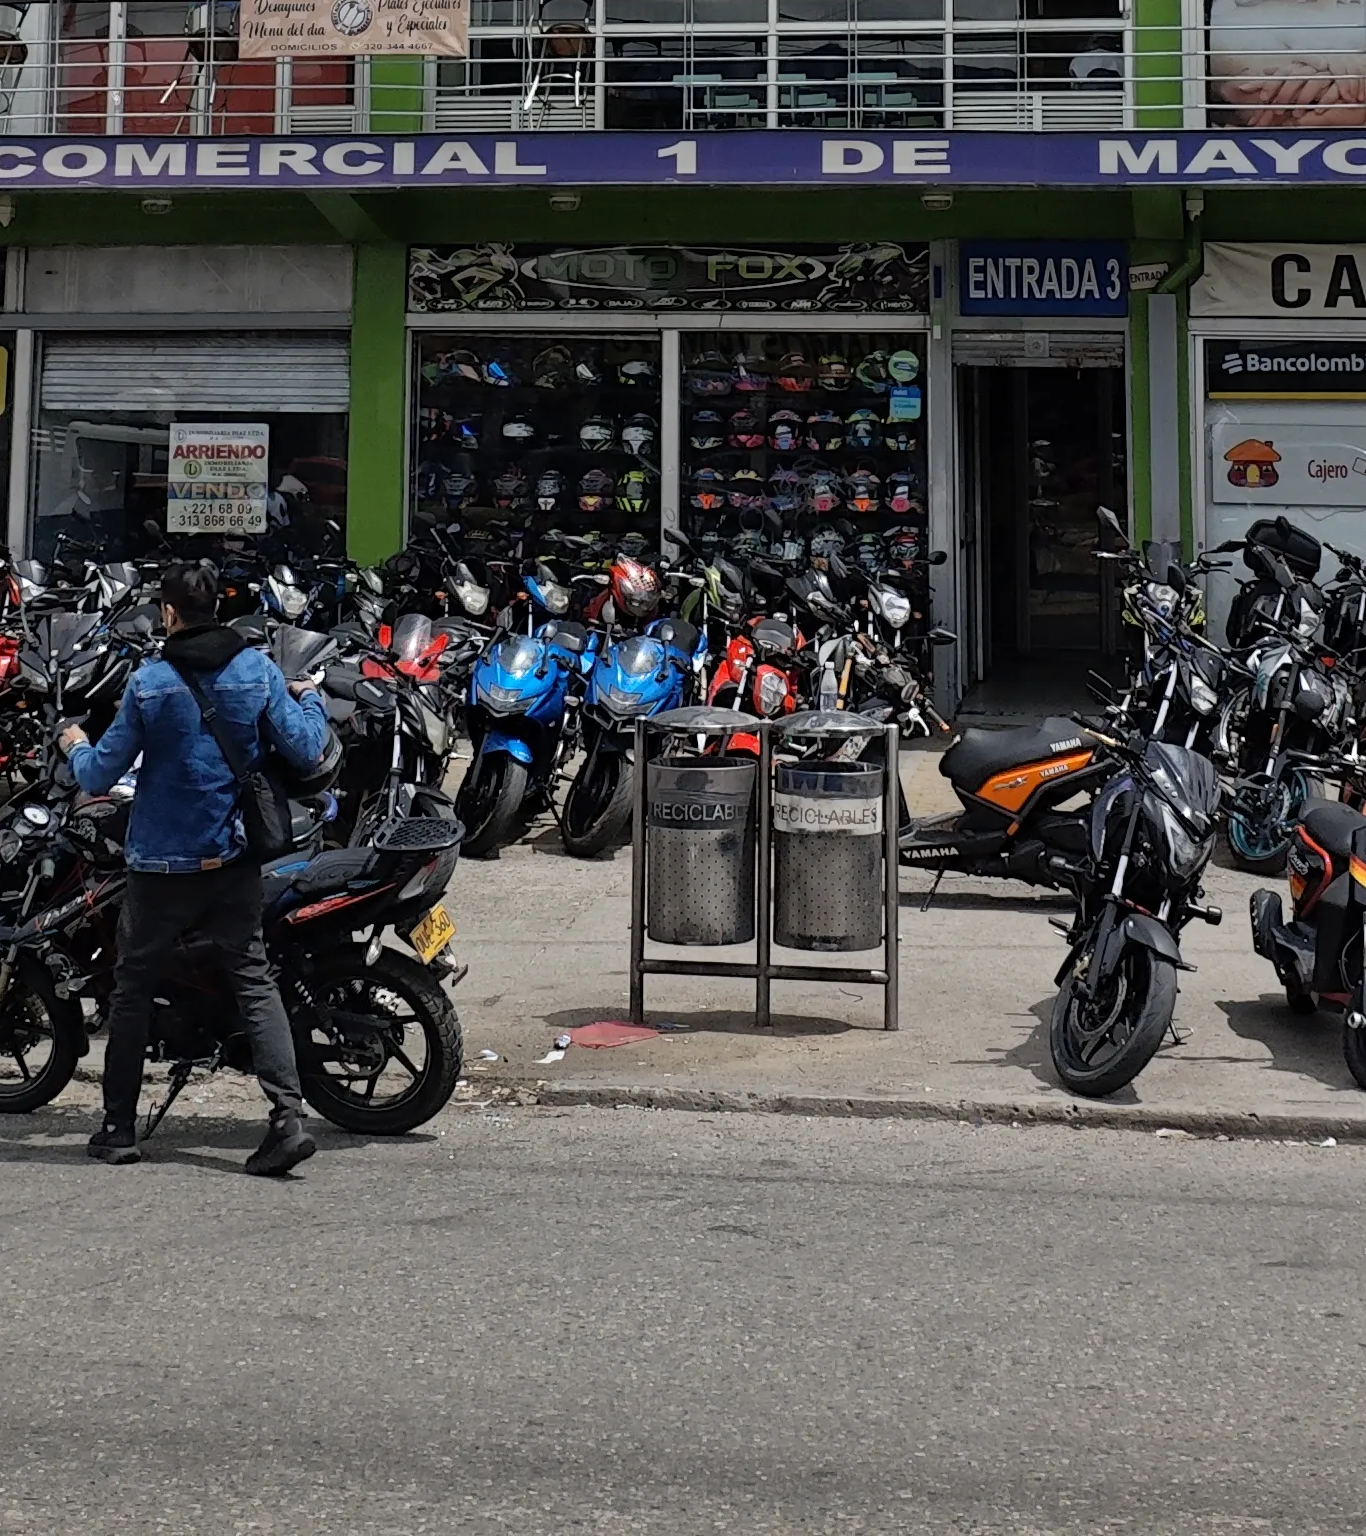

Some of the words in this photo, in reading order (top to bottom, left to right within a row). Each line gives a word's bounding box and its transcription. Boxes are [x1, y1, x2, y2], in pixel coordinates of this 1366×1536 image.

[287, 20, 304, 37] del
[397, 14, 448, 37] Especiales
[270, 43, 338, 52] DOMICILIOS
[363, 42, 384, 51] 320
[387, 42, 405, 51] 344
[656, 141, 697, 175] 1
[821, 138, 952, 175] DE
[538, 255, 676, 281] MOTO
[707, 255, 808, 282] FOX
[1129, 268, 1169, 284] ENTRADA
[968, 258, 1101, 300] ENTRADA
[1106, 258, 1121, 300] 3
[172, 444, 266, 460] ARRIENDO
[1307, 459, 1349, 484] Cajero
[191, 503, 213, 514] 221
[218, 503, 233, 514] 68
[237, 503, 253, 514] 09
[178, 515, 200, 526] 313
[203, 515, 225, 527] 868
[229, 515, 244, 527] 66
[247, 515, 262, 527] 49
[1050, 737, 1082, 753] YAMAHA
[1040, 764, 1069, 778] YAMAHA
[903, 846, 960, 860] YAMAHA
